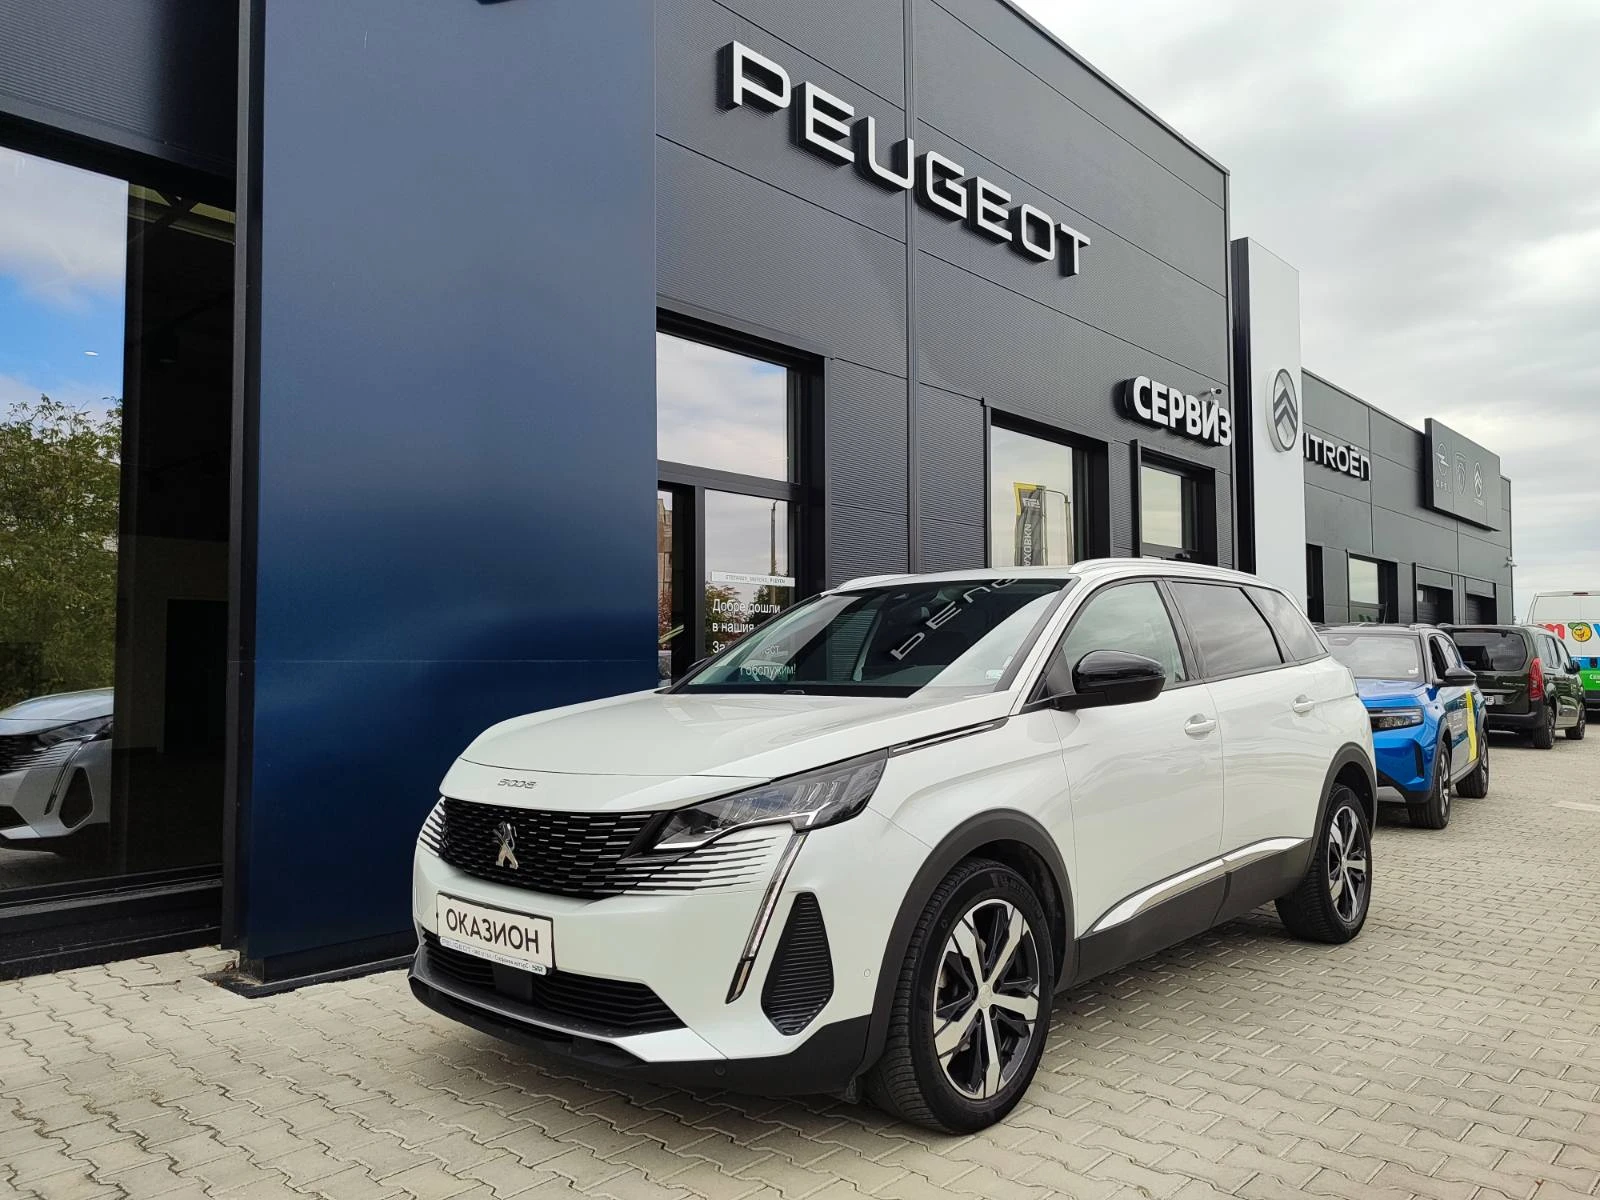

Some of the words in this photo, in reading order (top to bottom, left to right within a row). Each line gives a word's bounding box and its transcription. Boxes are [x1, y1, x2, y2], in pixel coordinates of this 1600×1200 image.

[731, 40, 1091, 276] PEUGEOT
[1132, 375, 1232, 447] СЕРВИЗ
[1303, 431, 1372, 481] ITROËN
[712, 598, 746, 615] Добре
[748, 603, 781, 614] дошли
[446, 908, 540, 955] ОКАЗИОН
